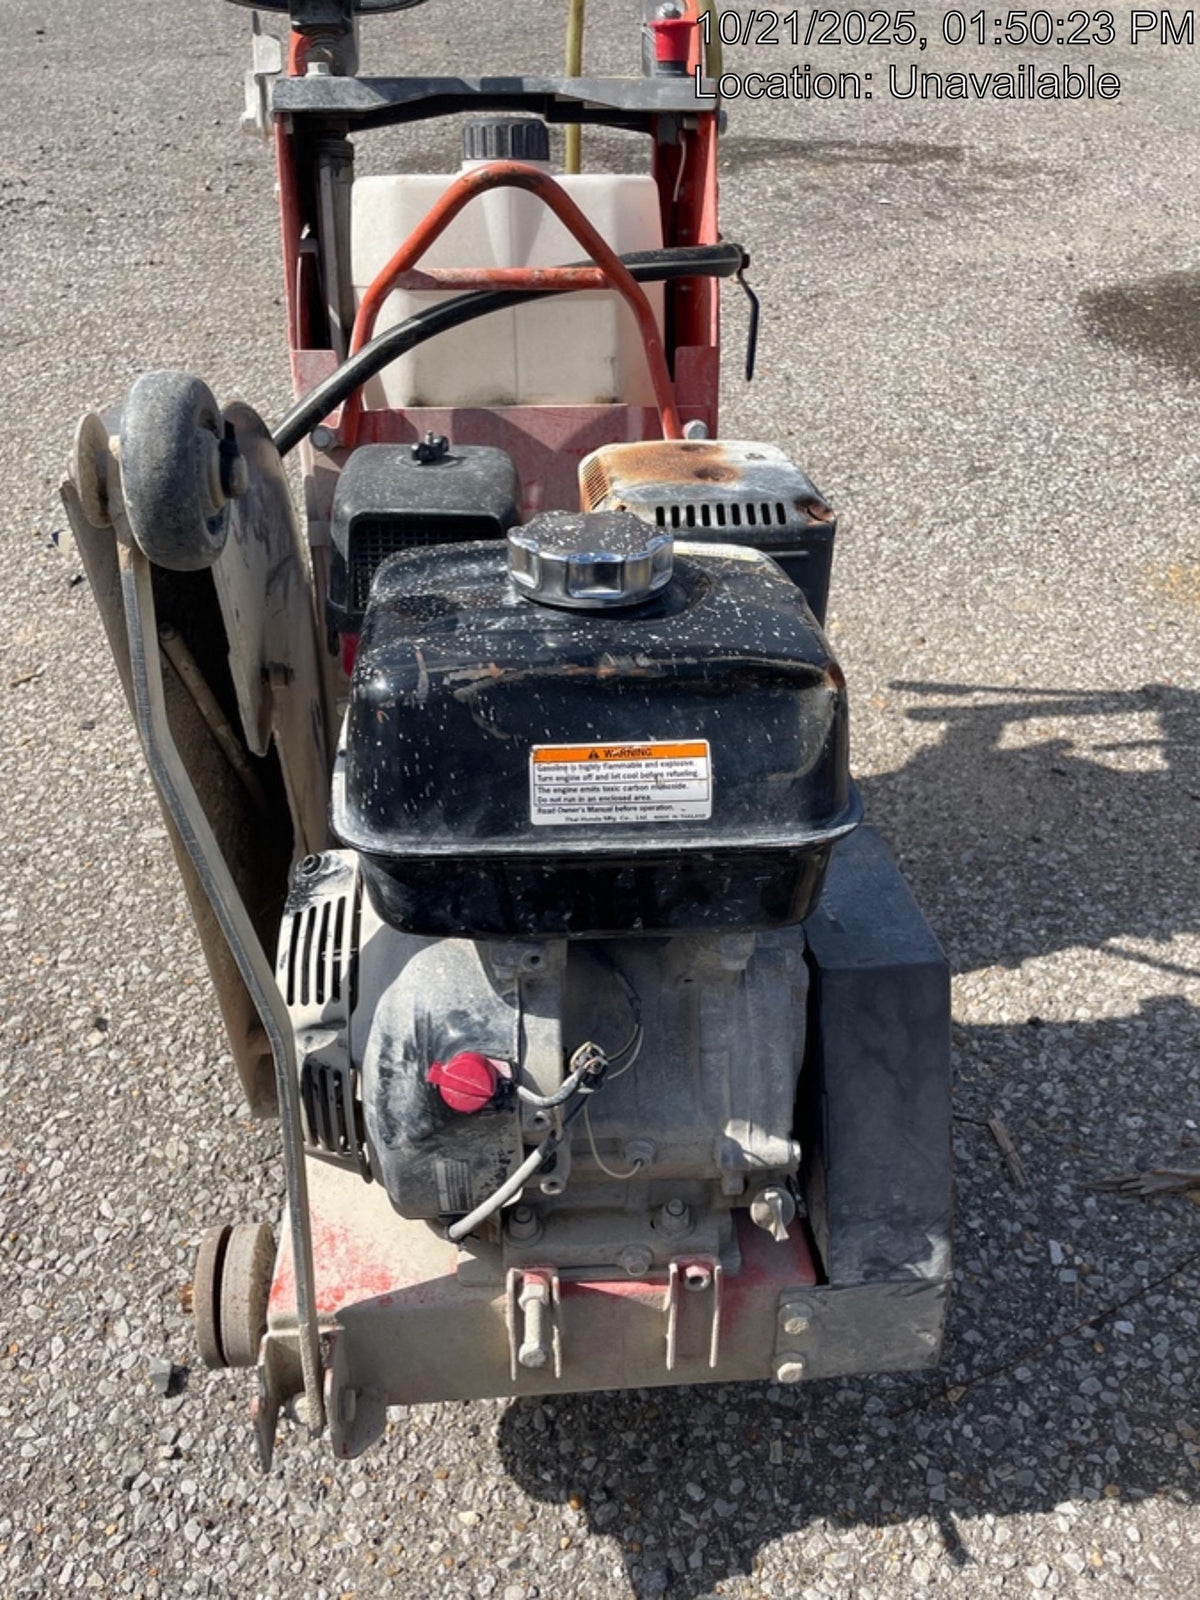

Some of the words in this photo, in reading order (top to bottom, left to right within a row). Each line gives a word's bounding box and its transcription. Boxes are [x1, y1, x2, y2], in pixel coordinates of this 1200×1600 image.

[604, 747, 653, 758] WARNING
[537, 764, 567, 772] Gasoline
[570, 763, 576, 772] is
[578, 763, 600, 772] highly
[602, 761, 642, 769] flammable
[556, 774, 579, 783] engine
[640, 804, 674, 812] operation.
